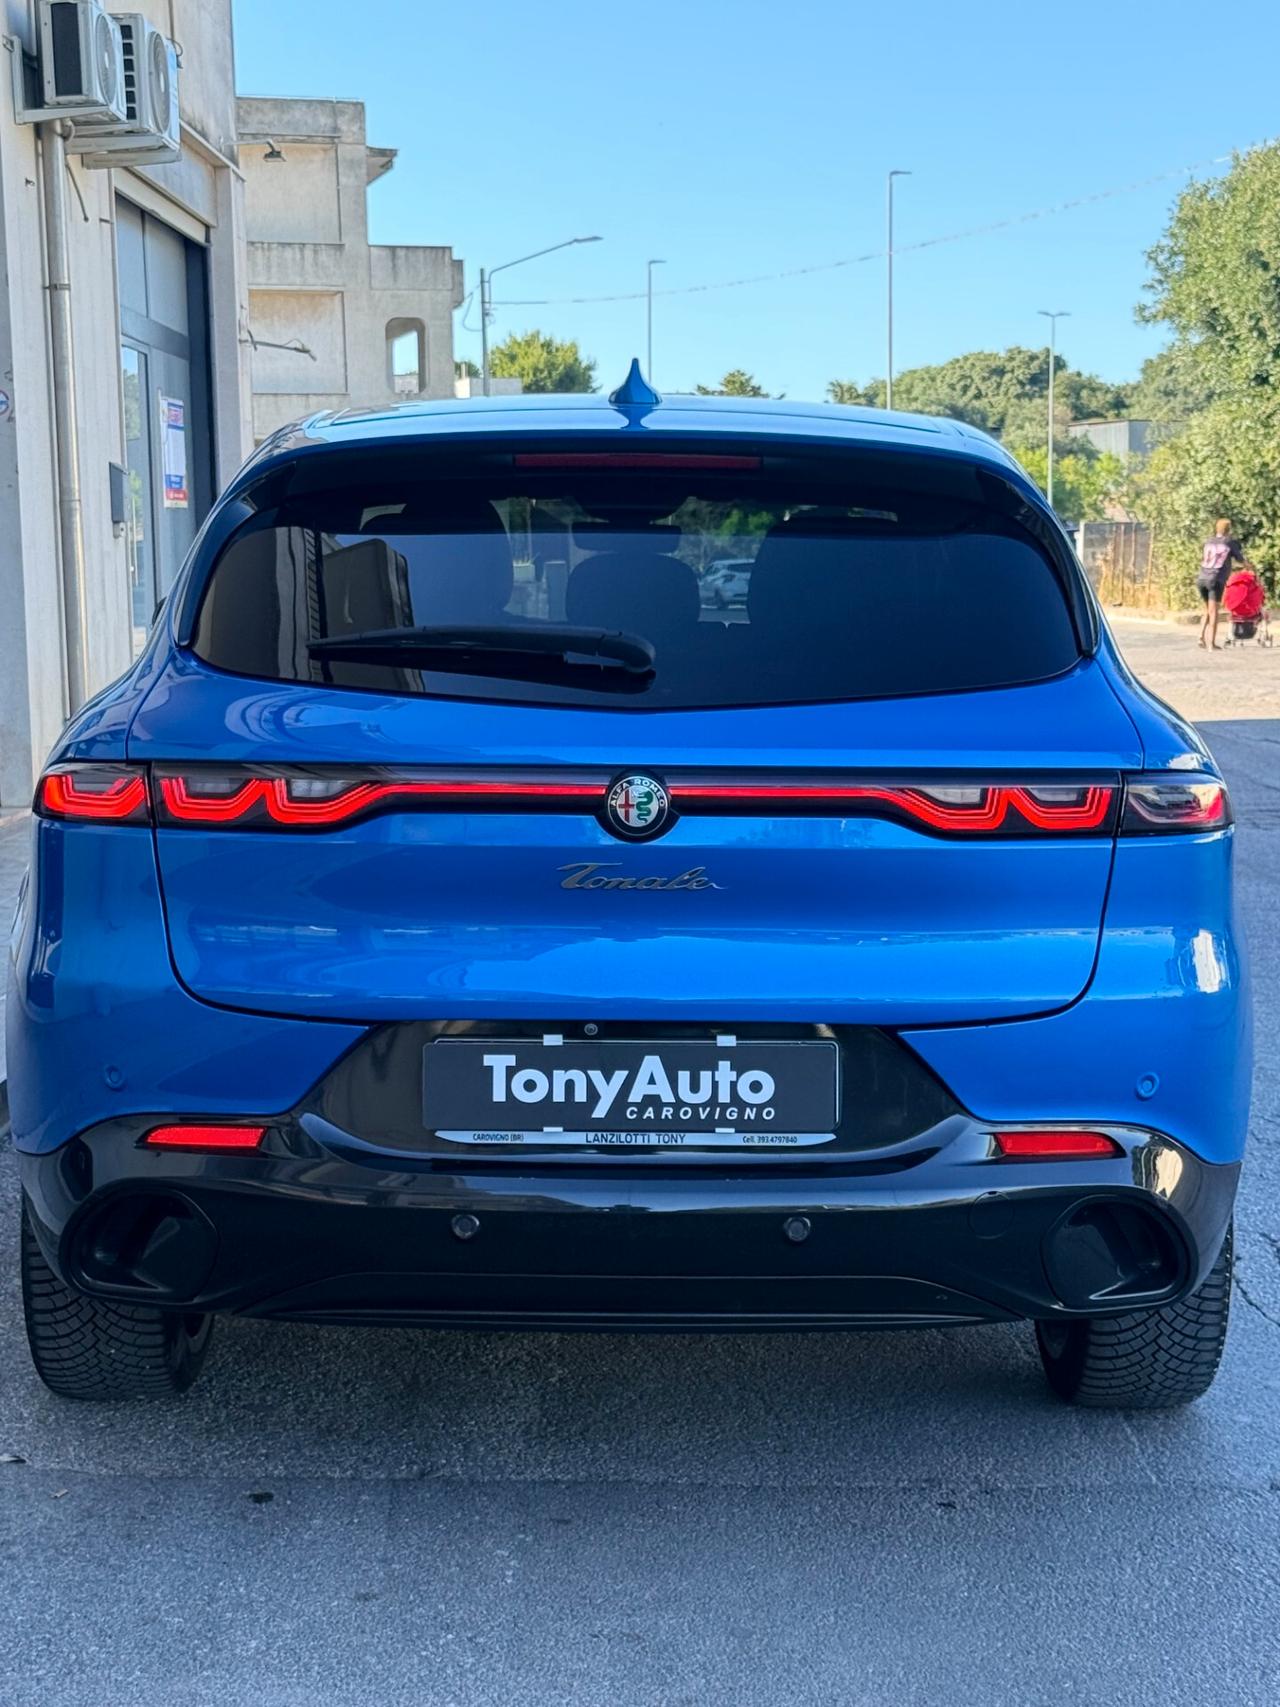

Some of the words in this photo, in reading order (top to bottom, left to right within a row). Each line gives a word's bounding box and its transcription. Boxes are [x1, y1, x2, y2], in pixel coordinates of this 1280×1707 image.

[610, 782, 630, 807] ALFA
[634, 778, 665, 807] ROMEO
[556, 862, 728, 890] Tonale
[625, 1106, 776, 1120] CAROVIGNO
[472, 1133, 510, 1142] CAROVIGNO
[585, 1133, 651, 1144] LANZILOTTI
[655, 1133, 686, 1144] TONY
